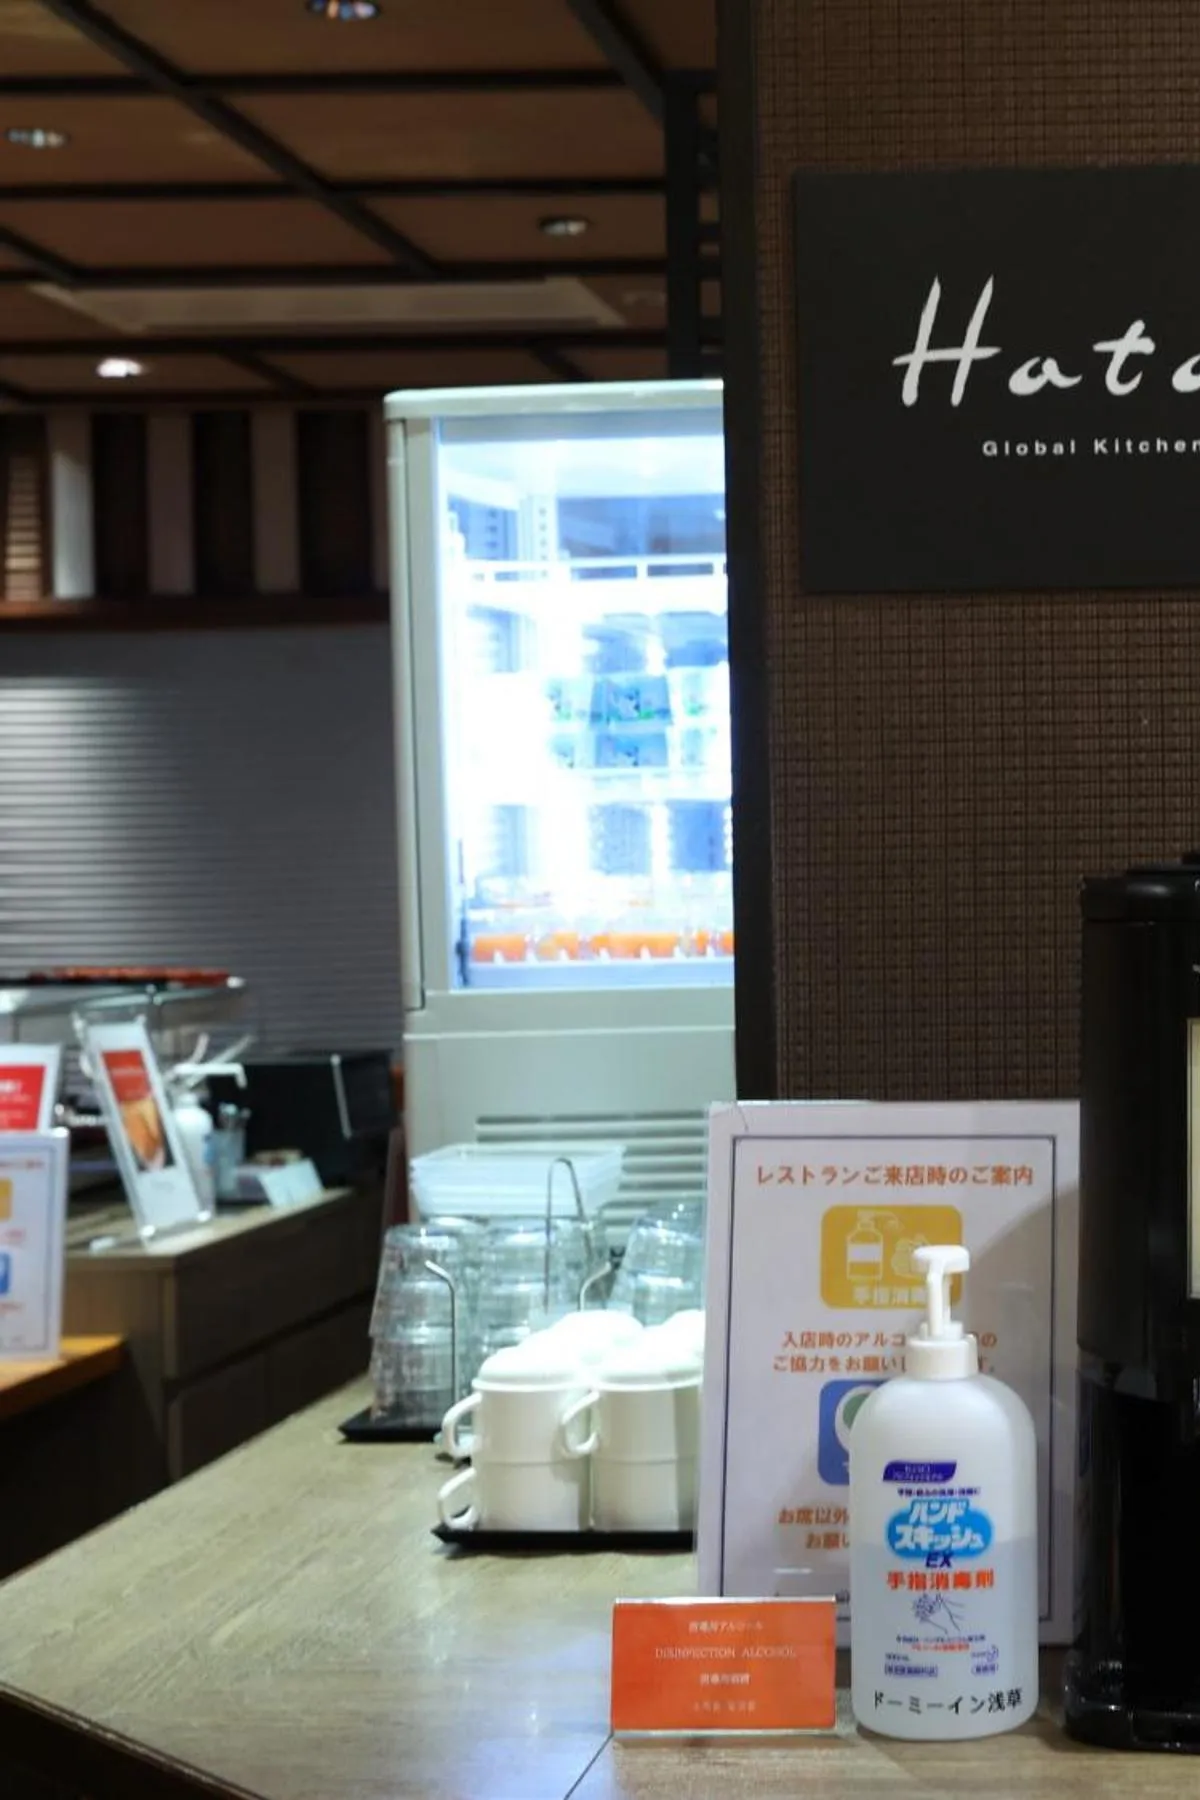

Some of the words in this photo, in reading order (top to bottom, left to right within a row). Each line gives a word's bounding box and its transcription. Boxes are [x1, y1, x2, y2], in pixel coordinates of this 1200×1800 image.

[981, 437, 1077, 458] Global
[755, 1163, 1034, 1186] レストランご来店時のご案内
[908, 1500, 970, 1525] ハンド
[894, 1521, 986, 1552] スキッシュ
[925, 1551, 953, 1569] EX
[886, 1568, 995, 1592] 手指消毒剤
[874, 1688, 1023, 1715] ドーミーイン浅草
